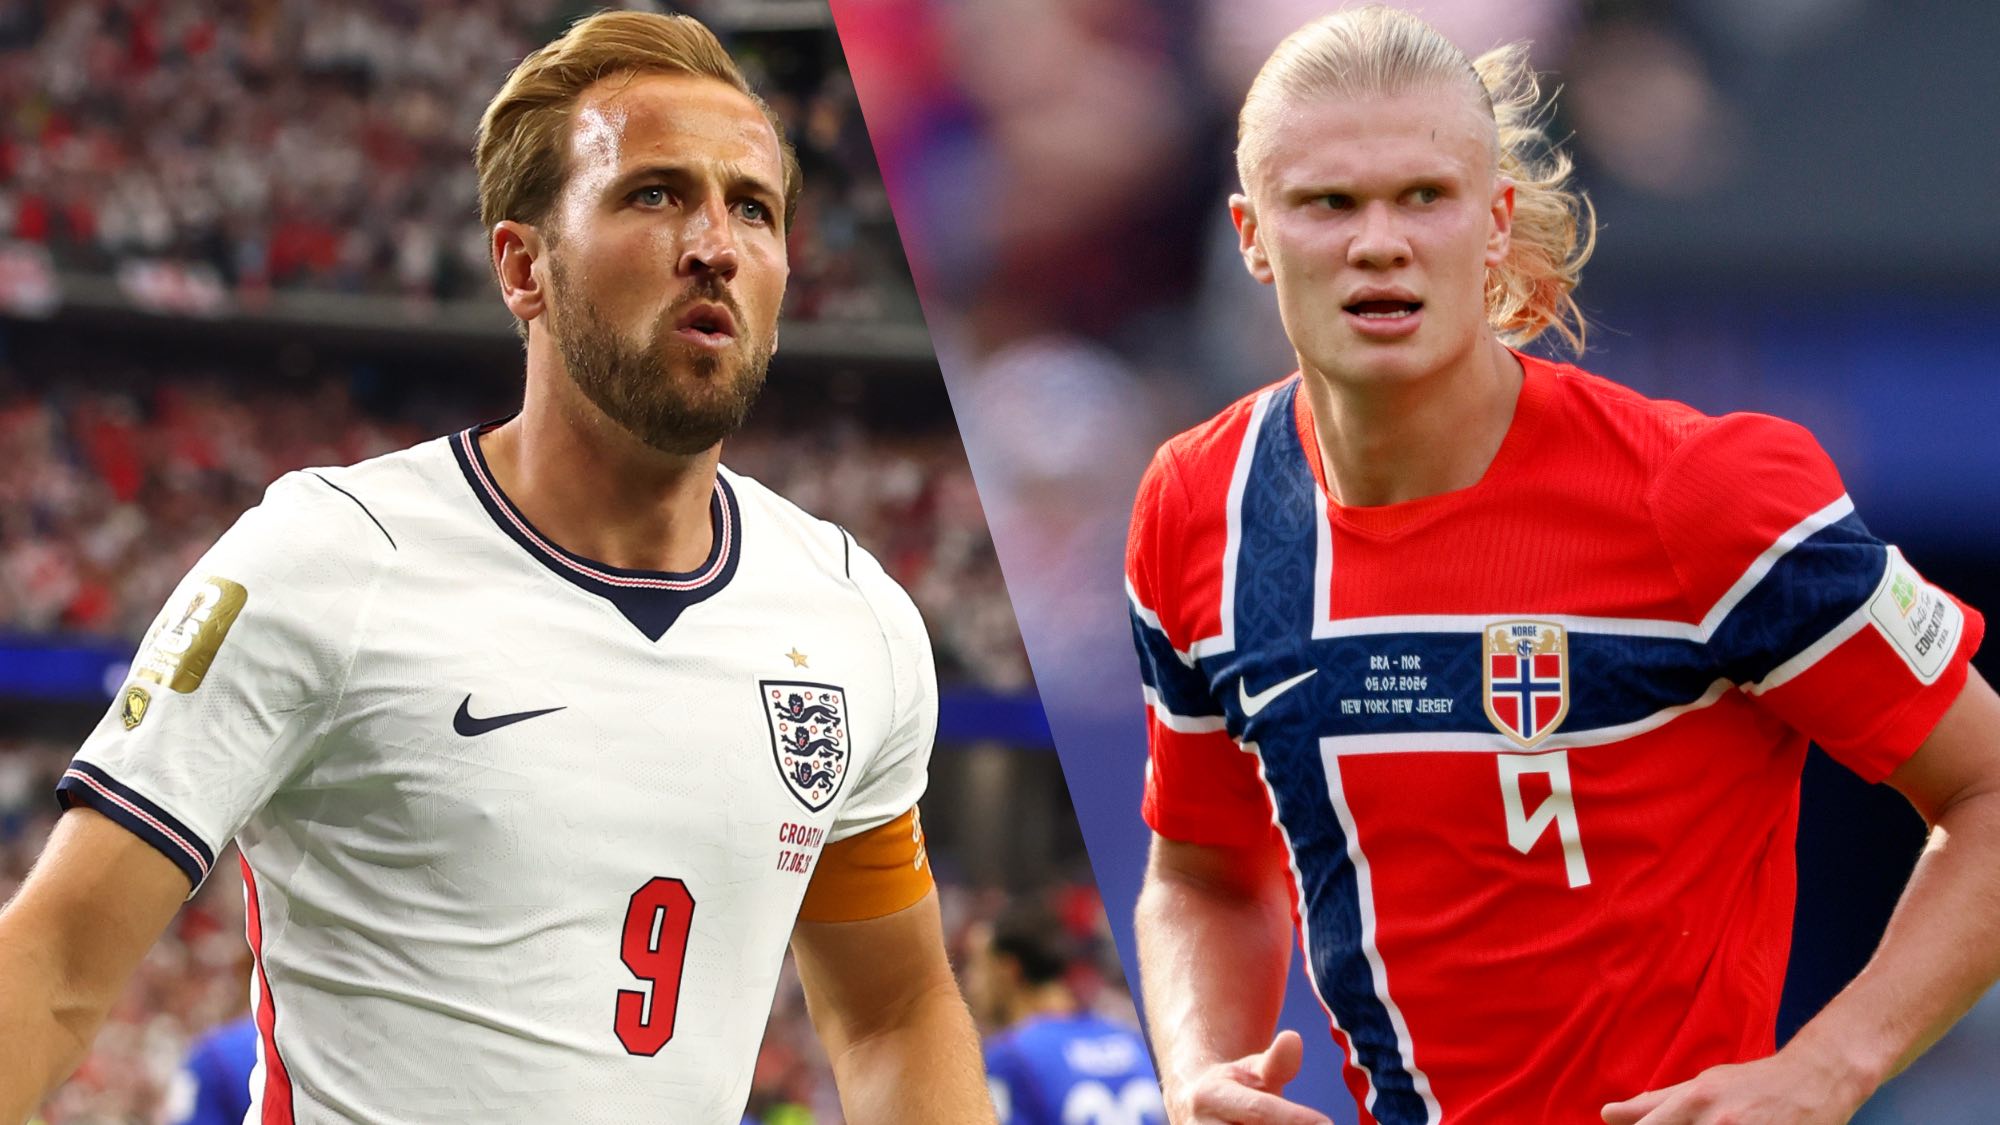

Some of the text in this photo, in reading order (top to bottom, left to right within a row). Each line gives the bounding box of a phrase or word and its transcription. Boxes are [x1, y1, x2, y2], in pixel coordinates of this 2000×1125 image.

[1512, 626, 1537, 637] NORGE
[1370, 655, 1390, 670] BRA
[1401, 655, 1421, 670] NOR
[1365, 676, 1428, 691] 05.07.2026
[1340, 699, 1454, 714] NEW YORK NEW JERSEY
[1497, 750, 1592, 889] 9
[613, 875, 697, 1058] 9
